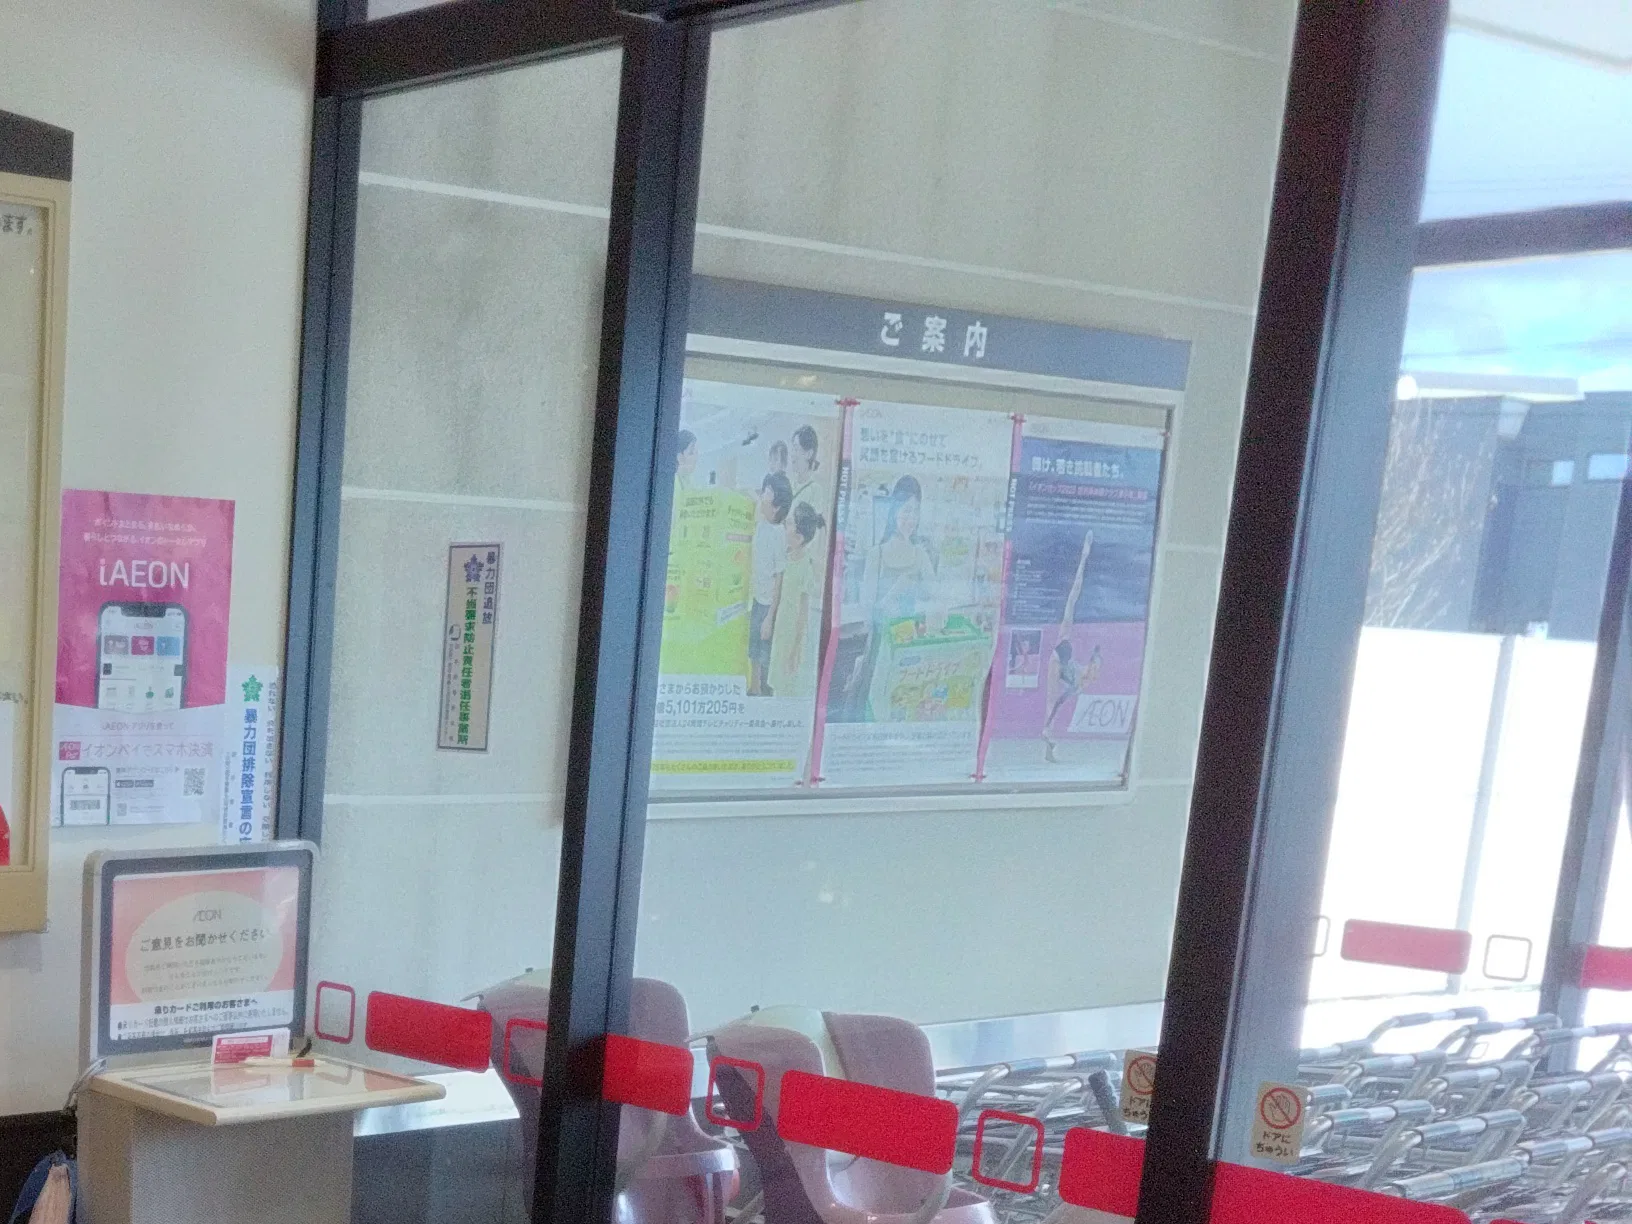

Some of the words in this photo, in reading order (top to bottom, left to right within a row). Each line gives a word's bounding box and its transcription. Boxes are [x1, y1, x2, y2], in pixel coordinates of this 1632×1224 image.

[879, 312, 989, 358] ご案内
[99, 557, 191, 589] iAEON
[481, 551, 497, 624] 暴力団追放
[1078, 699, 1129, 727] AEON
[239, 707, 258, 845] 暴力団排除宣言の
[1256, 1142, 1294, 1157] ちゅうい
[1263, 1131, 1292, 1144] ドアに
